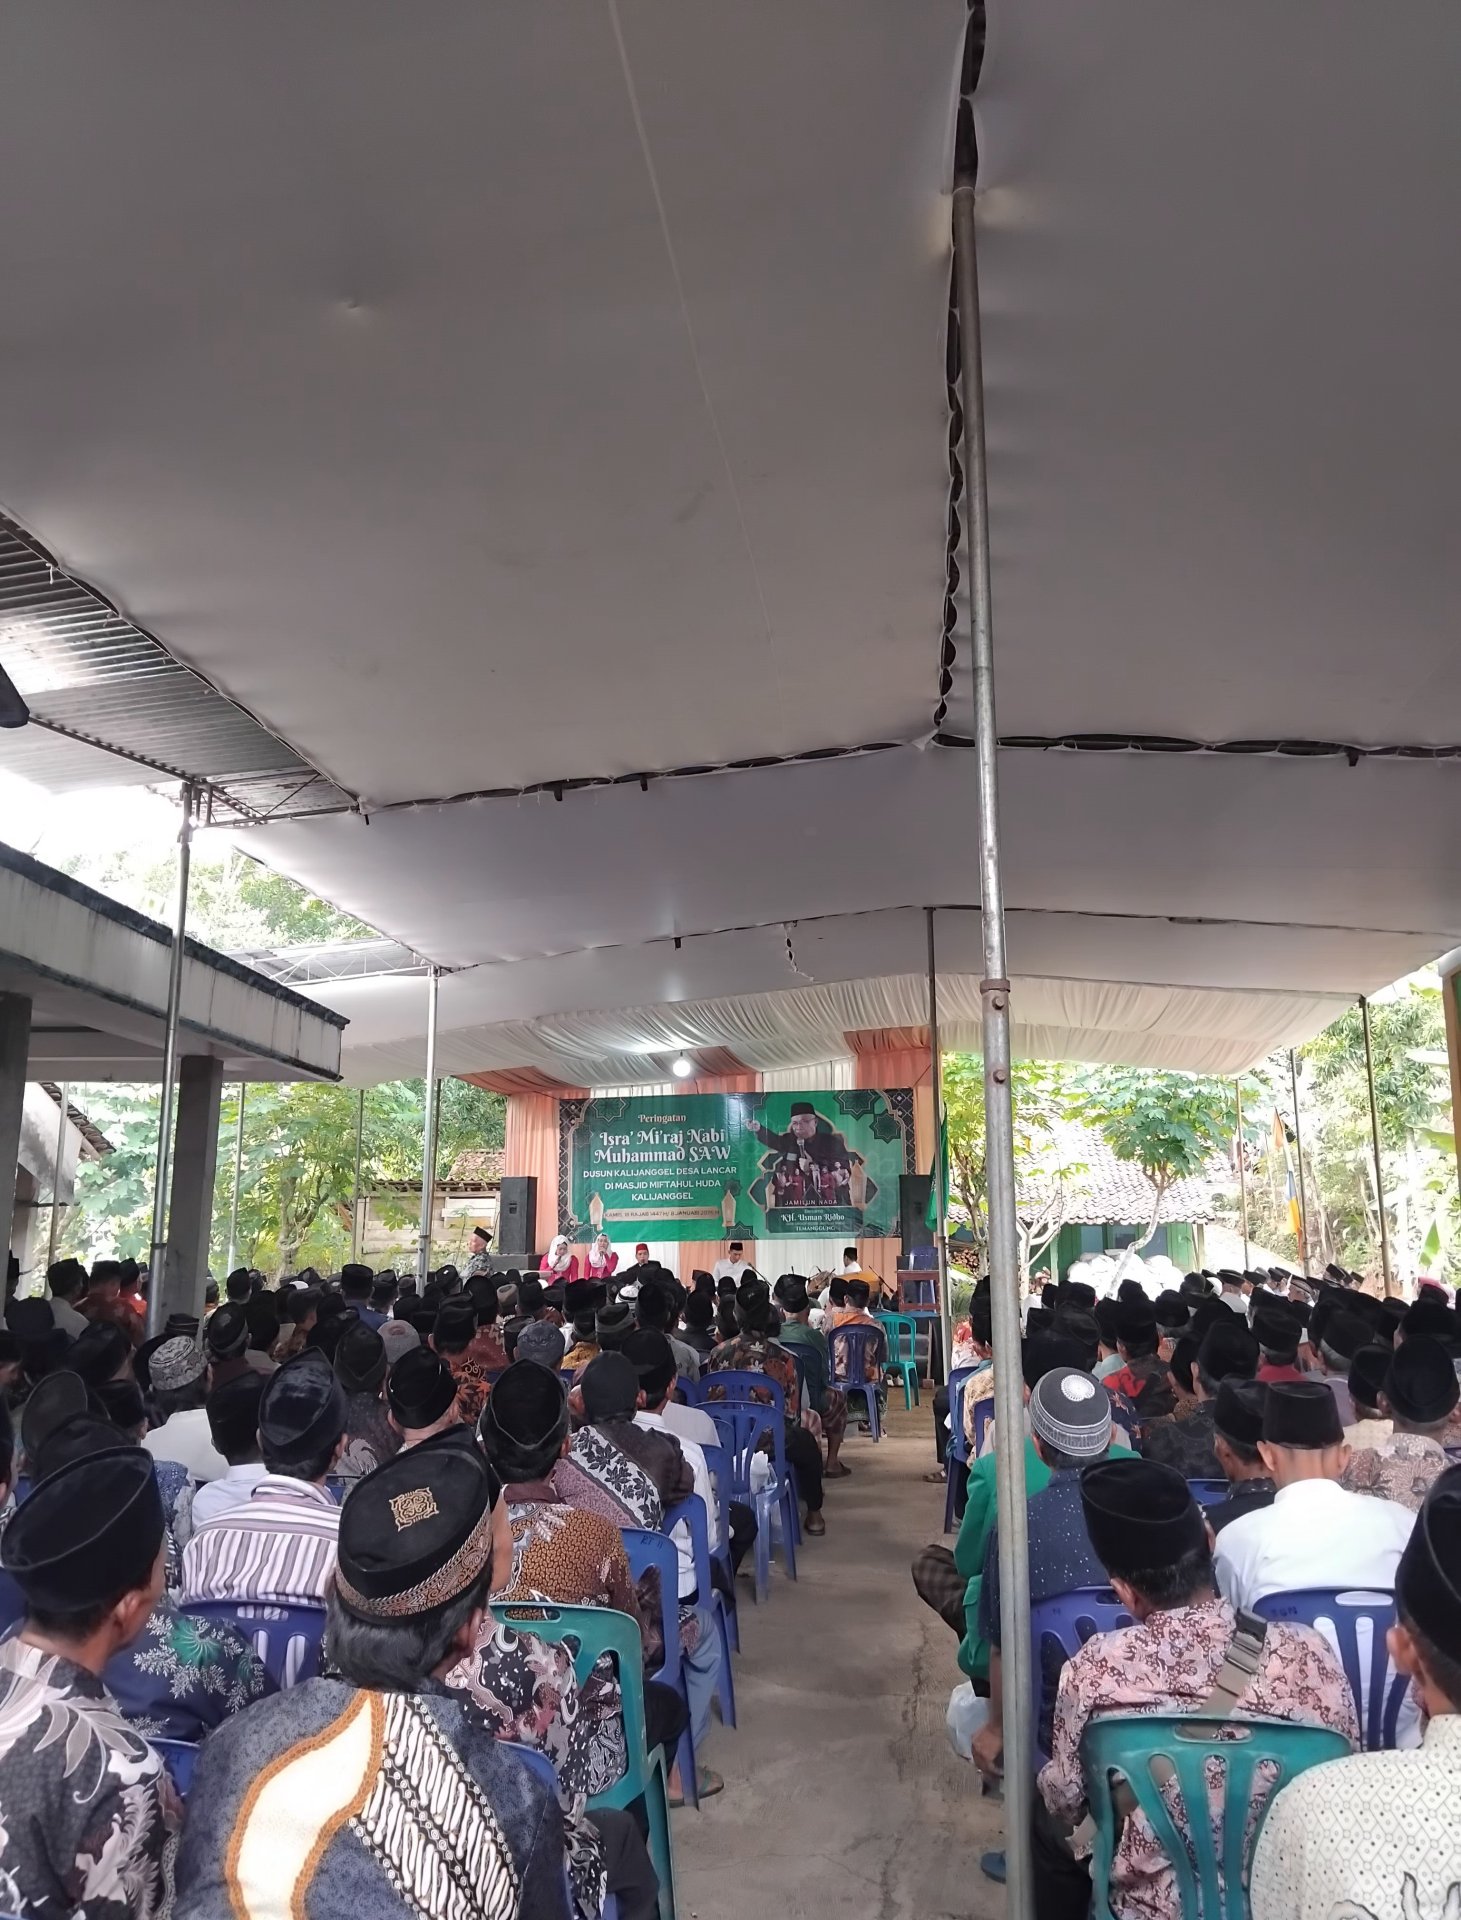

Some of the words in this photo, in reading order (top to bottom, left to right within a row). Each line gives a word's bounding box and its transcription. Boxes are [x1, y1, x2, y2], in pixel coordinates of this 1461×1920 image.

[638, 1114, 686, 1124] Peringatan
[687, 1128, 725, 1144] Nabi
[594, 1146, 685, 1164] Muhammad
[689, 1145, 731, 1162] SAW
[583, 1170, 612, 1178] DUSUN
[614, 1168, 674, 1177] KALIJANGGEL
[676, 1167, 699, 1175] DESA
[701, 1166, 737, 1174] LANCAR
[605, 1182, 614, 1190] DI
[615, 1181, 648, 1189] MASJID
[649, 1180, 694, 1188] MIFTAHUL
[631, 1193, 693, 1201] KALIJANGGEL
[781, 1212, 797, 1222] KH.
[797, 1213, 822, 1221] Usman
[823, 1212, 845, 1221] Ridho
